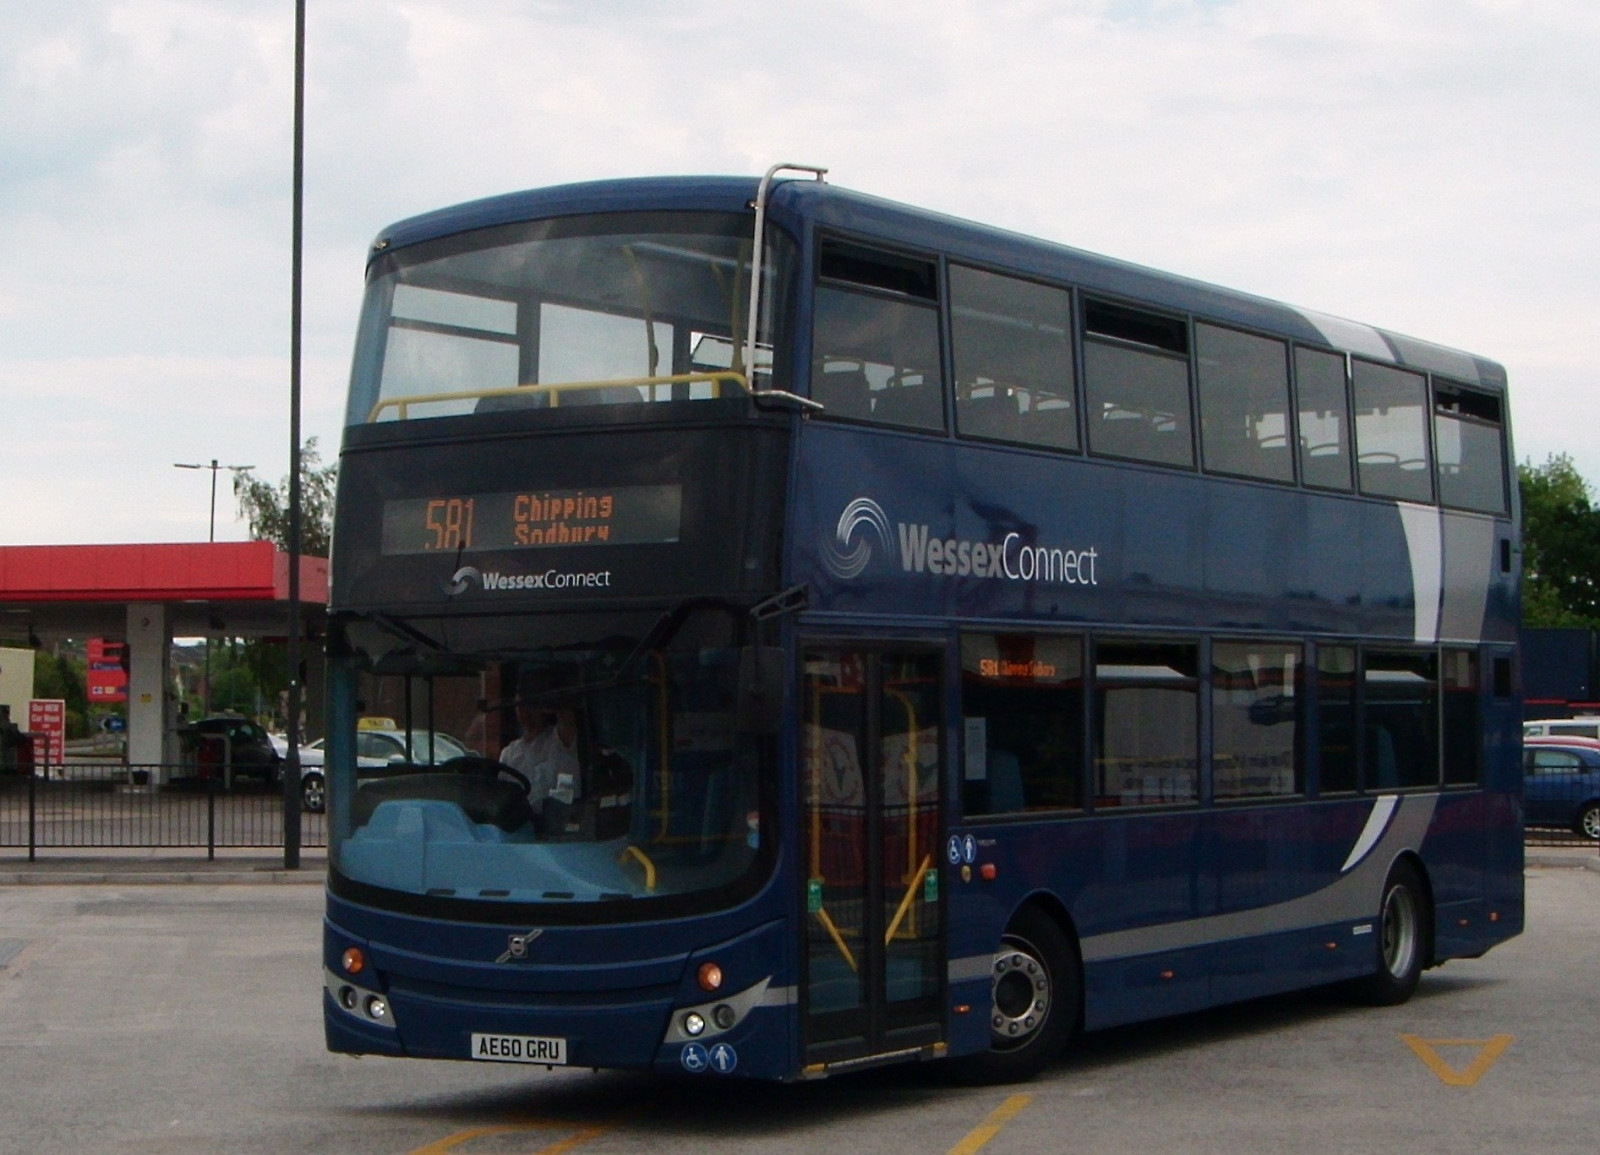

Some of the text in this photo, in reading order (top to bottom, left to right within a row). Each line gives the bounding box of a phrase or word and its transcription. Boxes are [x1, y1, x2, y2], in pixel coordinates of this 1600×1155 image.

[514, 491, 613, 521] Chipping
[898, 522, 1098, 585] WessexConnect
[482, 569, 611, 590] WessexConnect
[480, 1037, 559, 1059] AE60 GRU
